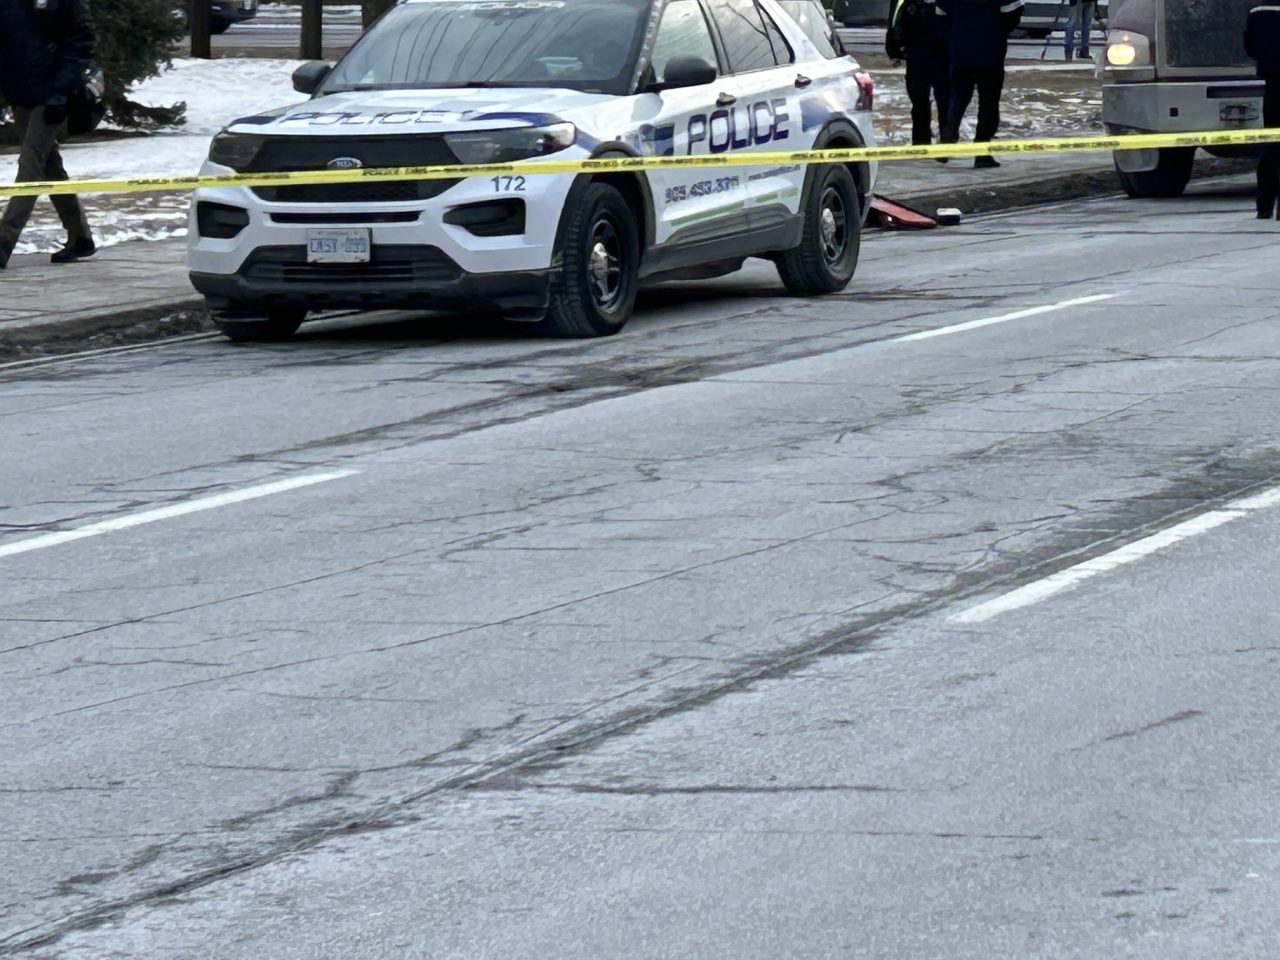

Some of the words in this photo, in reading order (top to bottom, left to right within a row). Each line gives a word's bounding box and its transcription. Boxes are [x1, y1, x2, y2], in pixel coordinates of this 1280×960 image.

[278, 110, 450, 126] POLICE
[686, 97, 790, 157] POLICE
[490, 175, 527, 192] 172
